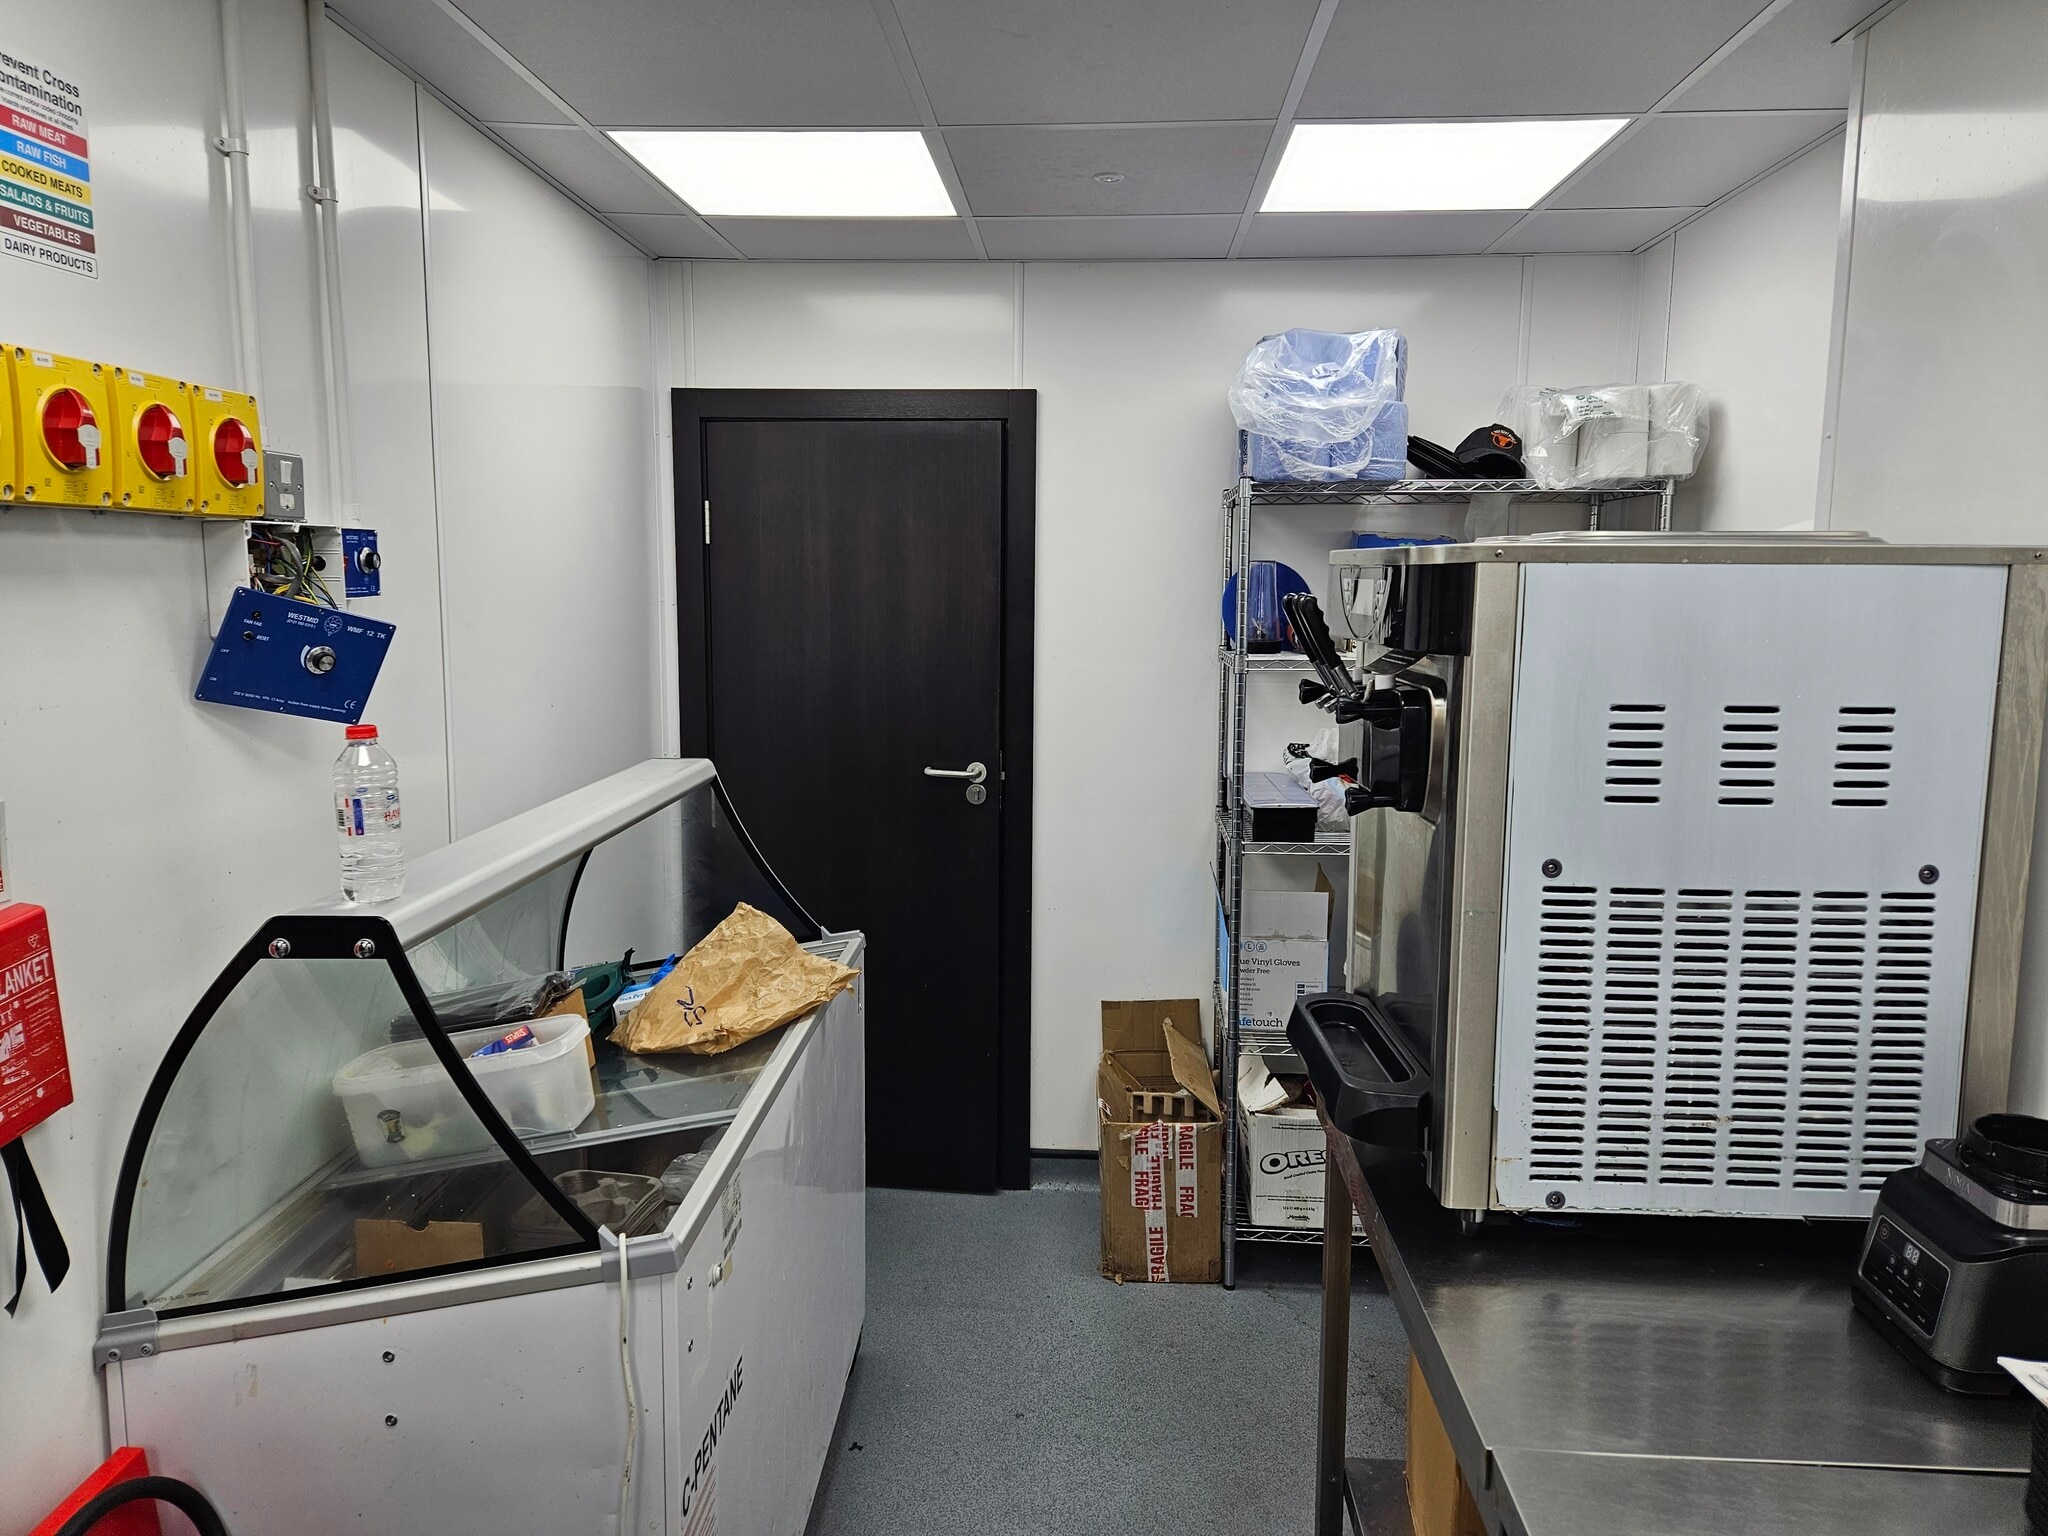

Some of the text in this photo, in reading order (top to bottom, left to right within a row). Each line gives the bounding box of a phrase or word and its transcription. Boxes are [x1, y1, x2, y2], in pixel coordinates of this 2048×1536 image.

[42, 69, 79, 98] Cross
[11, 113, 67, 146] RAW MEAT
[16, 140, 66, 169] RAW FISH
[1, 160, 83, 198] COOKED MEATS
[0, 184, 90, 224] SALADS & FRUITS
[13, 213, 81, 245] VEGETABLES
[4, 237, 93, 273] DAIRY PRODUCTS
[287, 611, 320, 624] WESTMID
[347, 625, 364, 634] WMF
[1251, 958, 1273, 967] Vinyl
[1273, 958, 1301, 967] Gloves
[682, 1354, 744, 1517] C-PENTANE
